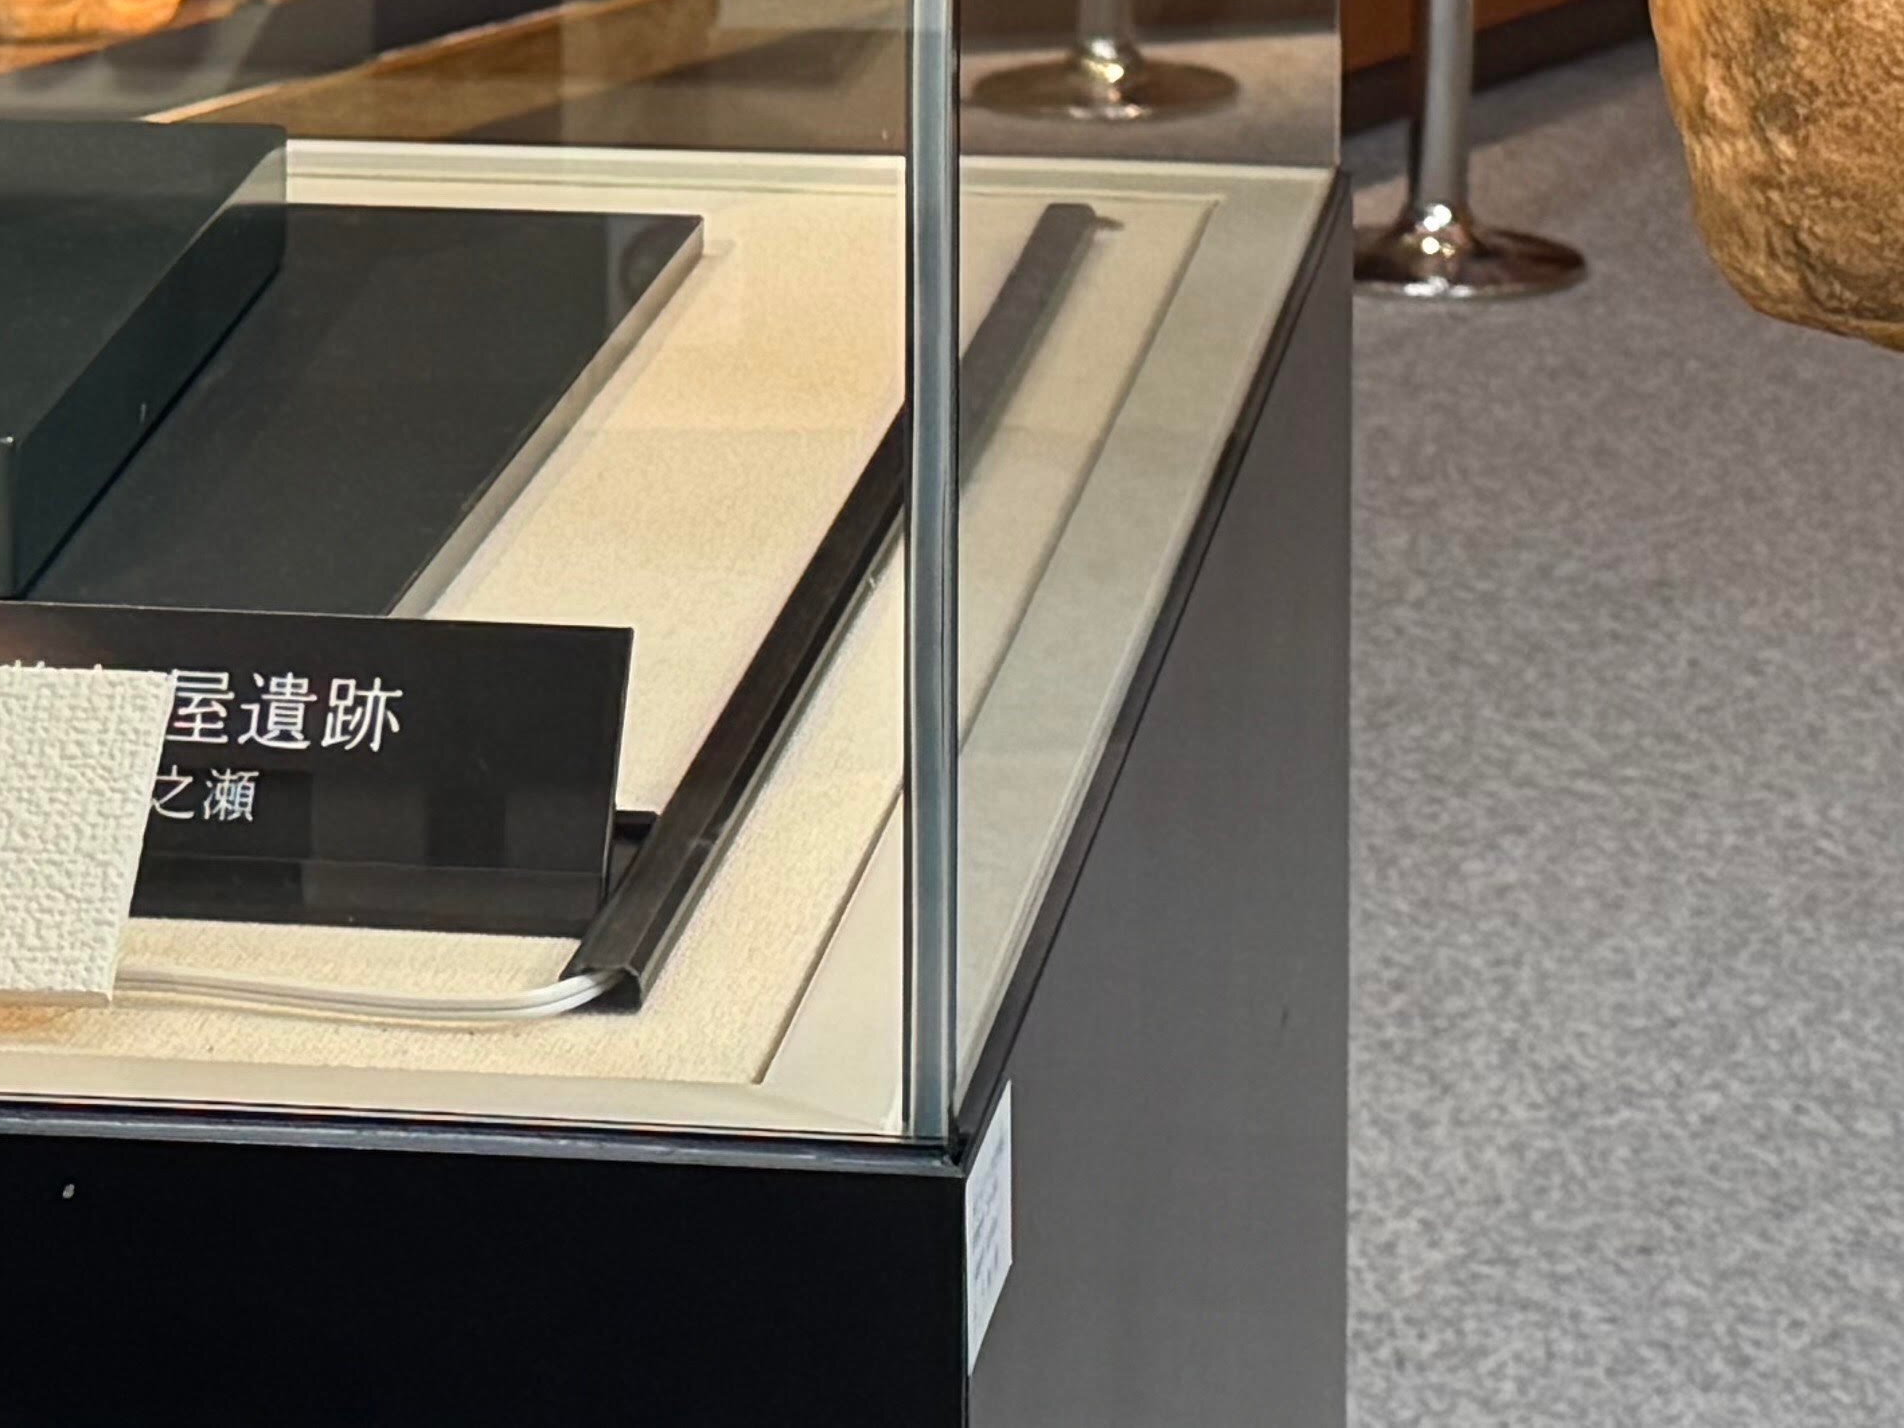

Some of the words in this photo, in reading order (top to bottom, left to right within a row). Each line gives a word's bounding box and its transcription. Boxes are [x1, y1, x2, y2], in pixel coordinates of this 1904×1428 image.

[164, 669, 403, 752] 屋遺跡
[150, 764, 260, 822] 之瀬
